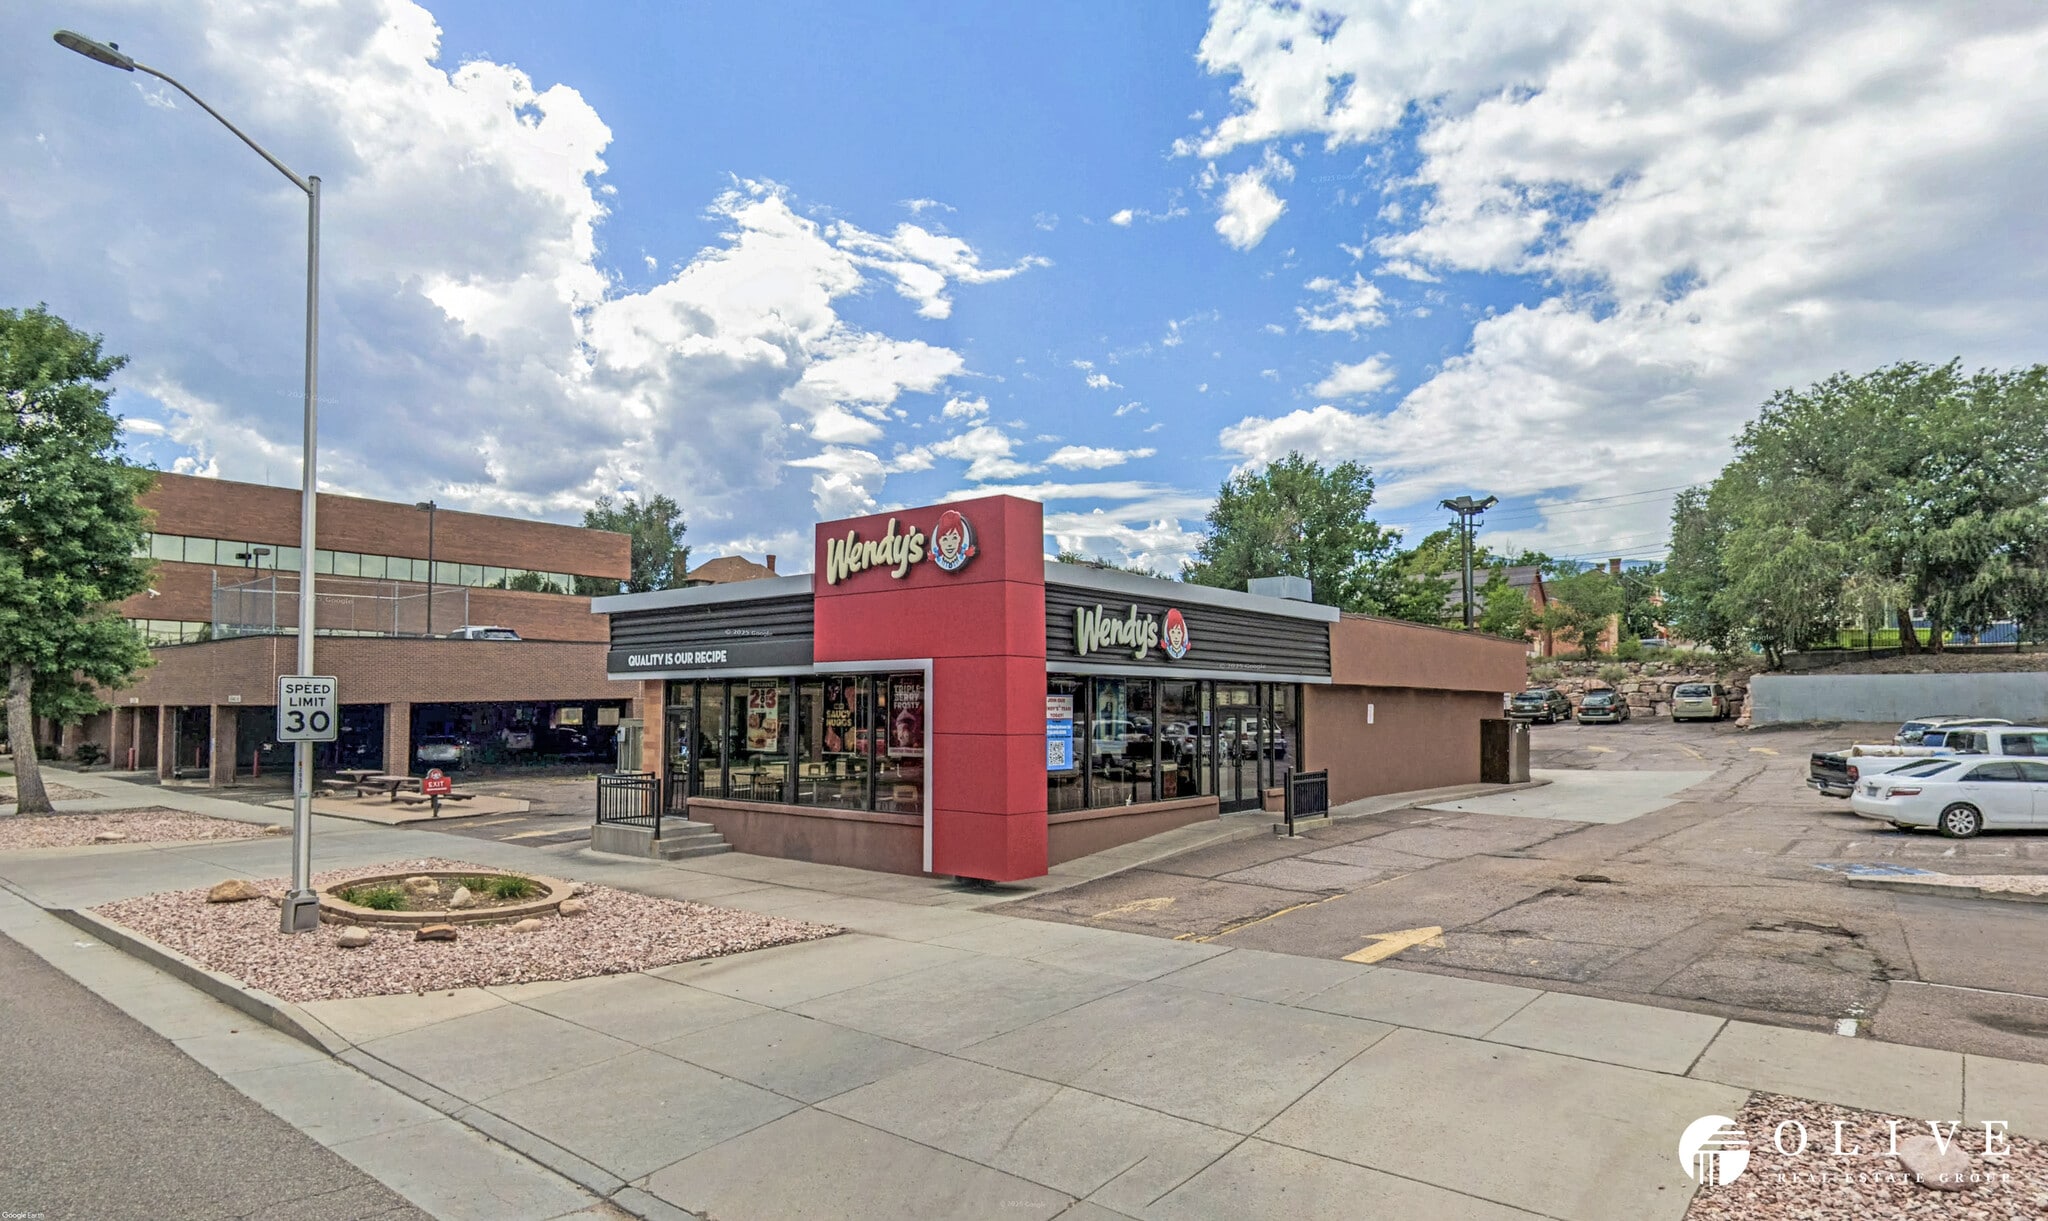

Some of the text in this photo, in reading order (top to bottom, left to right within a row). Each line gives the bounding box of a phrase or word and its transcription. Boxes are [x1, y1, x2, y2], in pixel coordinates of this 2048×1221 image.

[827, 518, 924, 585] Wendy's
[1075, 604, 1158, 660] Wendy's
[628, 650, 727, 667] QUALITY IS OUR RECIPE
[285, 684, 331, 694] SPEED
[894, 684, 920, 693] TRIPLE
[289, 697, 326, 707] LIMIT
[750, 689, 760, 709] 2
[765, 689, 777, 709] 3
[894, 701, 920, 709] FROSTY
[826, 709, 851, 719] SAUCY
[285, 710, 330, 733] 30
[826, 718, 852, 727] NUGGS
[427, 780, 445, 788] EXIT
